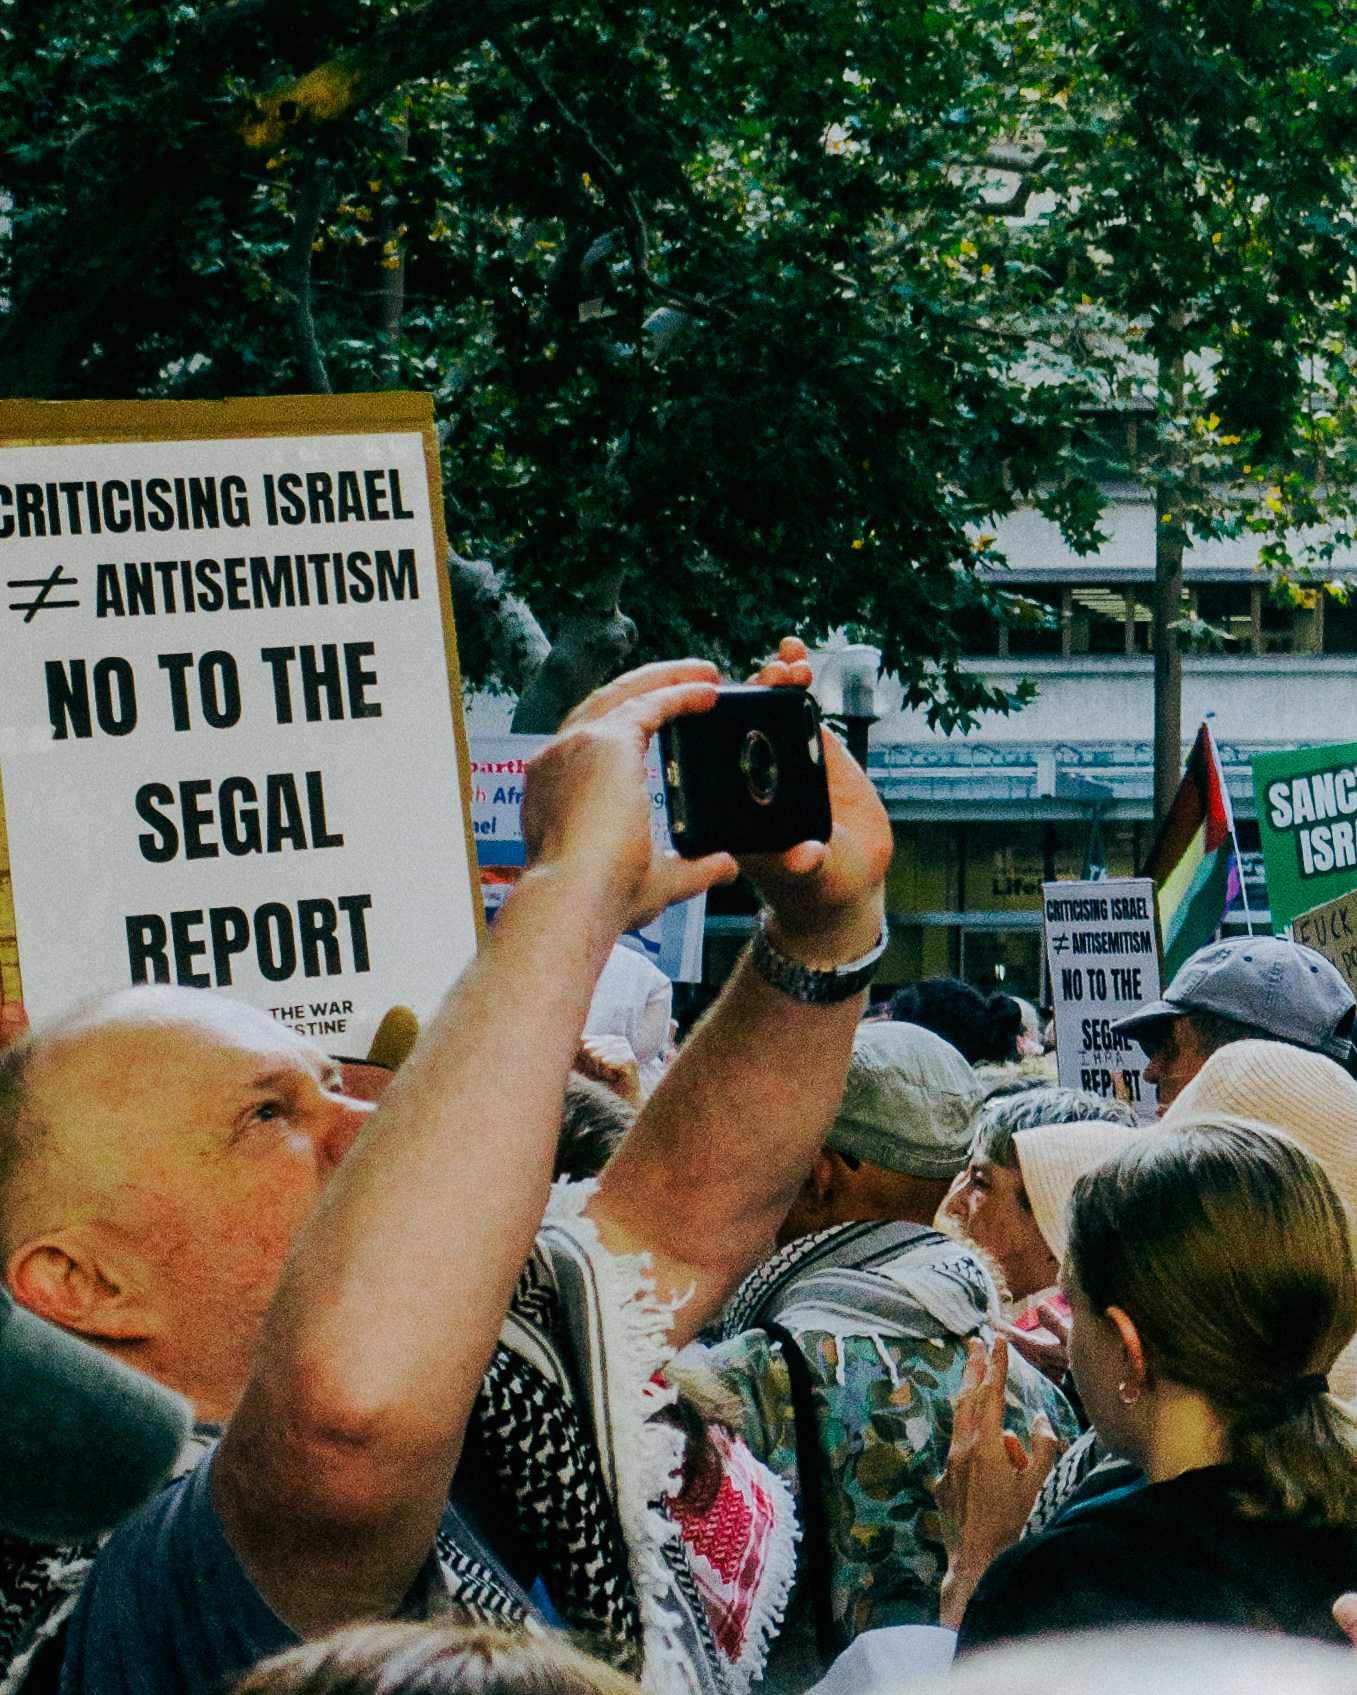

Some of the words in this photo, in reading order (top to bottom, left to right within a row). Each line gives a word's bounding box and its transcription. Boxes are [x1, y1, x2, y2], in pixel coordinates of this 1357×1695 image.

[264, 469, 414, 526] ISRAEL
[96, 548, 420, 618] ANTISEMITISM
[45, 657, 138, 740] NO
[158, 650, 242, 732] TO
[261, 641, 383, 724] THE
[493, 786, 524, 805] Afr
[134, 770, 345, 863] SEGAL
[1046, 898, 1108, 922] CRITICISING
[1111, 897, 1149, 921] ISRAEL
[125, 894, 372, 989] REPORT
[1072, 931, 1152, 954] ANTISEMITISM
[1300, 907, 1353, 946] FUCK
[1062, 968, 1083, 1001] NO
[1087, 968, 1107, 1001] TO
[1111, 968, 1142, 1001] THE
[268, 1005, 305, 1020] THE
[309, 1000, 353, 1017] WAR
[285, 1019, 347, 1035] STINE
[1081, 1069, 1141, 1102] REPRT
